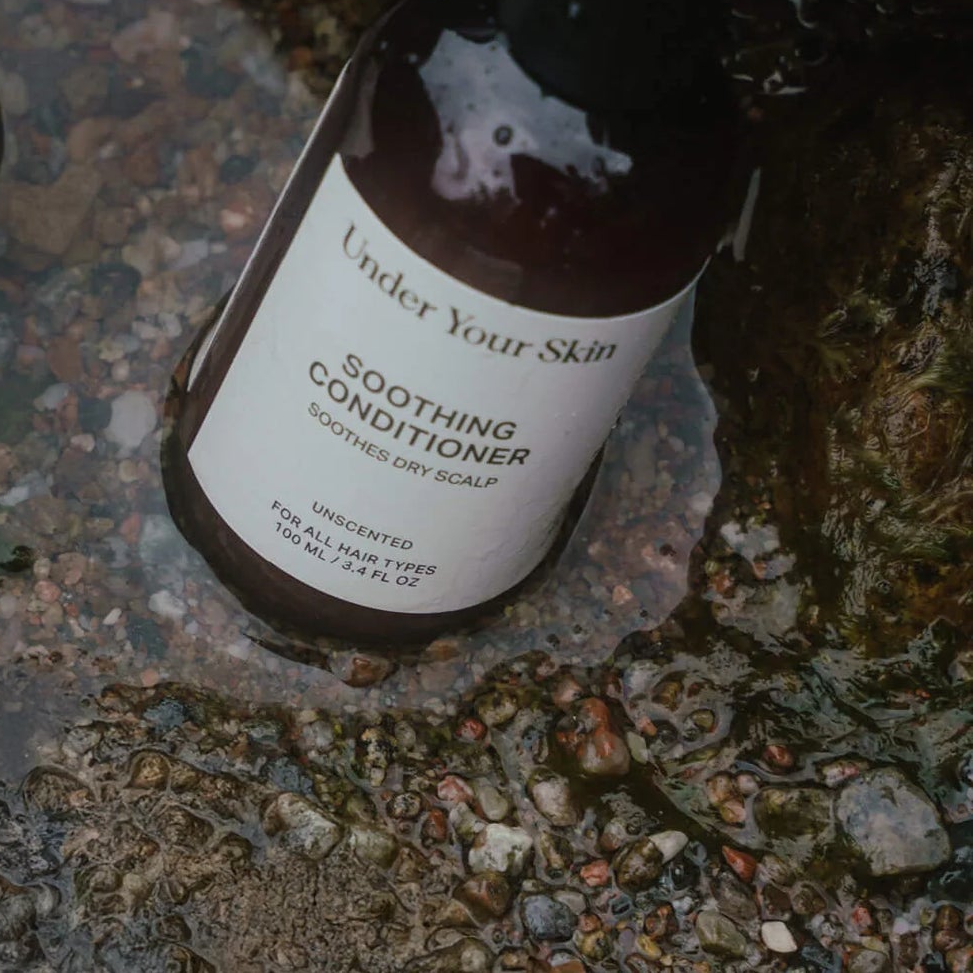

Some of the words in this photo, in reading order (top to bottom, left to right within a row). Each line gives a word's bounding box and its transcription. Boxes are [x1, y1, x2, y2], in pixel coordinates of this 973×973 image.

[341, 222, 438, 320] Under
[445, 305, 535, 360] Your
[538, 338, 618, 364] Skin
[309, 361, 530, 466] CONDITIONER
[342, 353, 517, 441] SOOTHING
[307, 402, 390, 462] SOOTHES
[392, 456, 433, 477] DRY
[434, 470, 499, 489] SCALP
[271, 500, 302, 528] FOR
[303, 526, 333, 548] ALL
[337, 543, 379, 565] HAIR
[384, 558, 438, 576] TYPES
[274, 522, 301, 545] 100
[304, 542, 326, 561] ML
[330, 556, 339, 564] /
[341, 560, 367, 576] 3.4
[371, 570, 390, 583] FL
[395, 576, 421, 587] OZ
[312, 501, 413, 550] UNSCENTED
